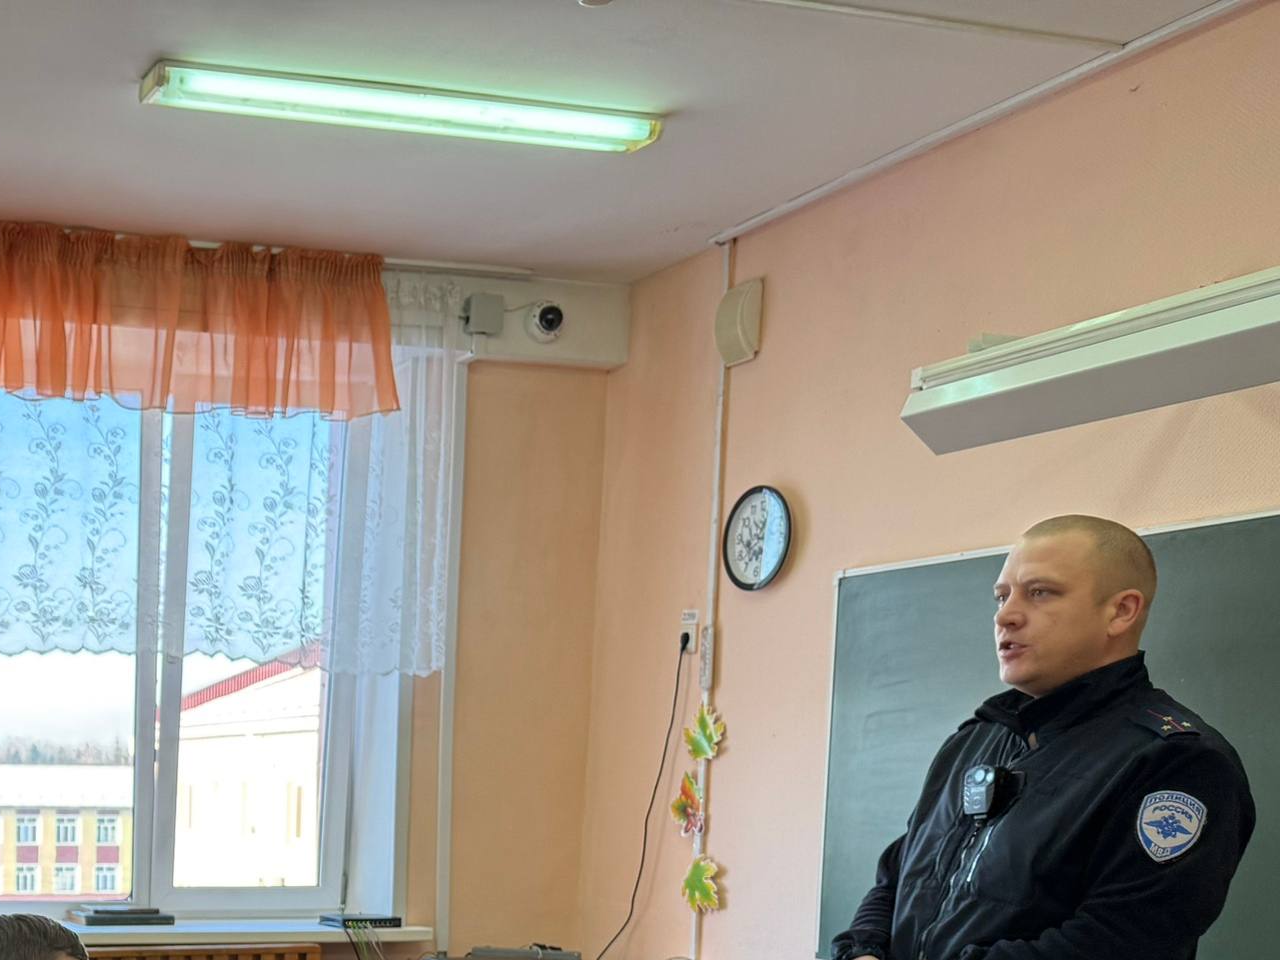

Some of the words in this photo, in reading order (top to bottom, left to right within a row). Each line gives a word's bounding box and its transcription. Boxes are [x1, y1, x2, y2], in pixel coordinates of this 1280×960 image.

[742, 517, 750, 528] 10
[1146, 794, 1201, 816] ПОЛИЦИЯ
[1152, 804, 1193, 822] РОССИЯ
[1150, 842, 1171, 856] МВД
